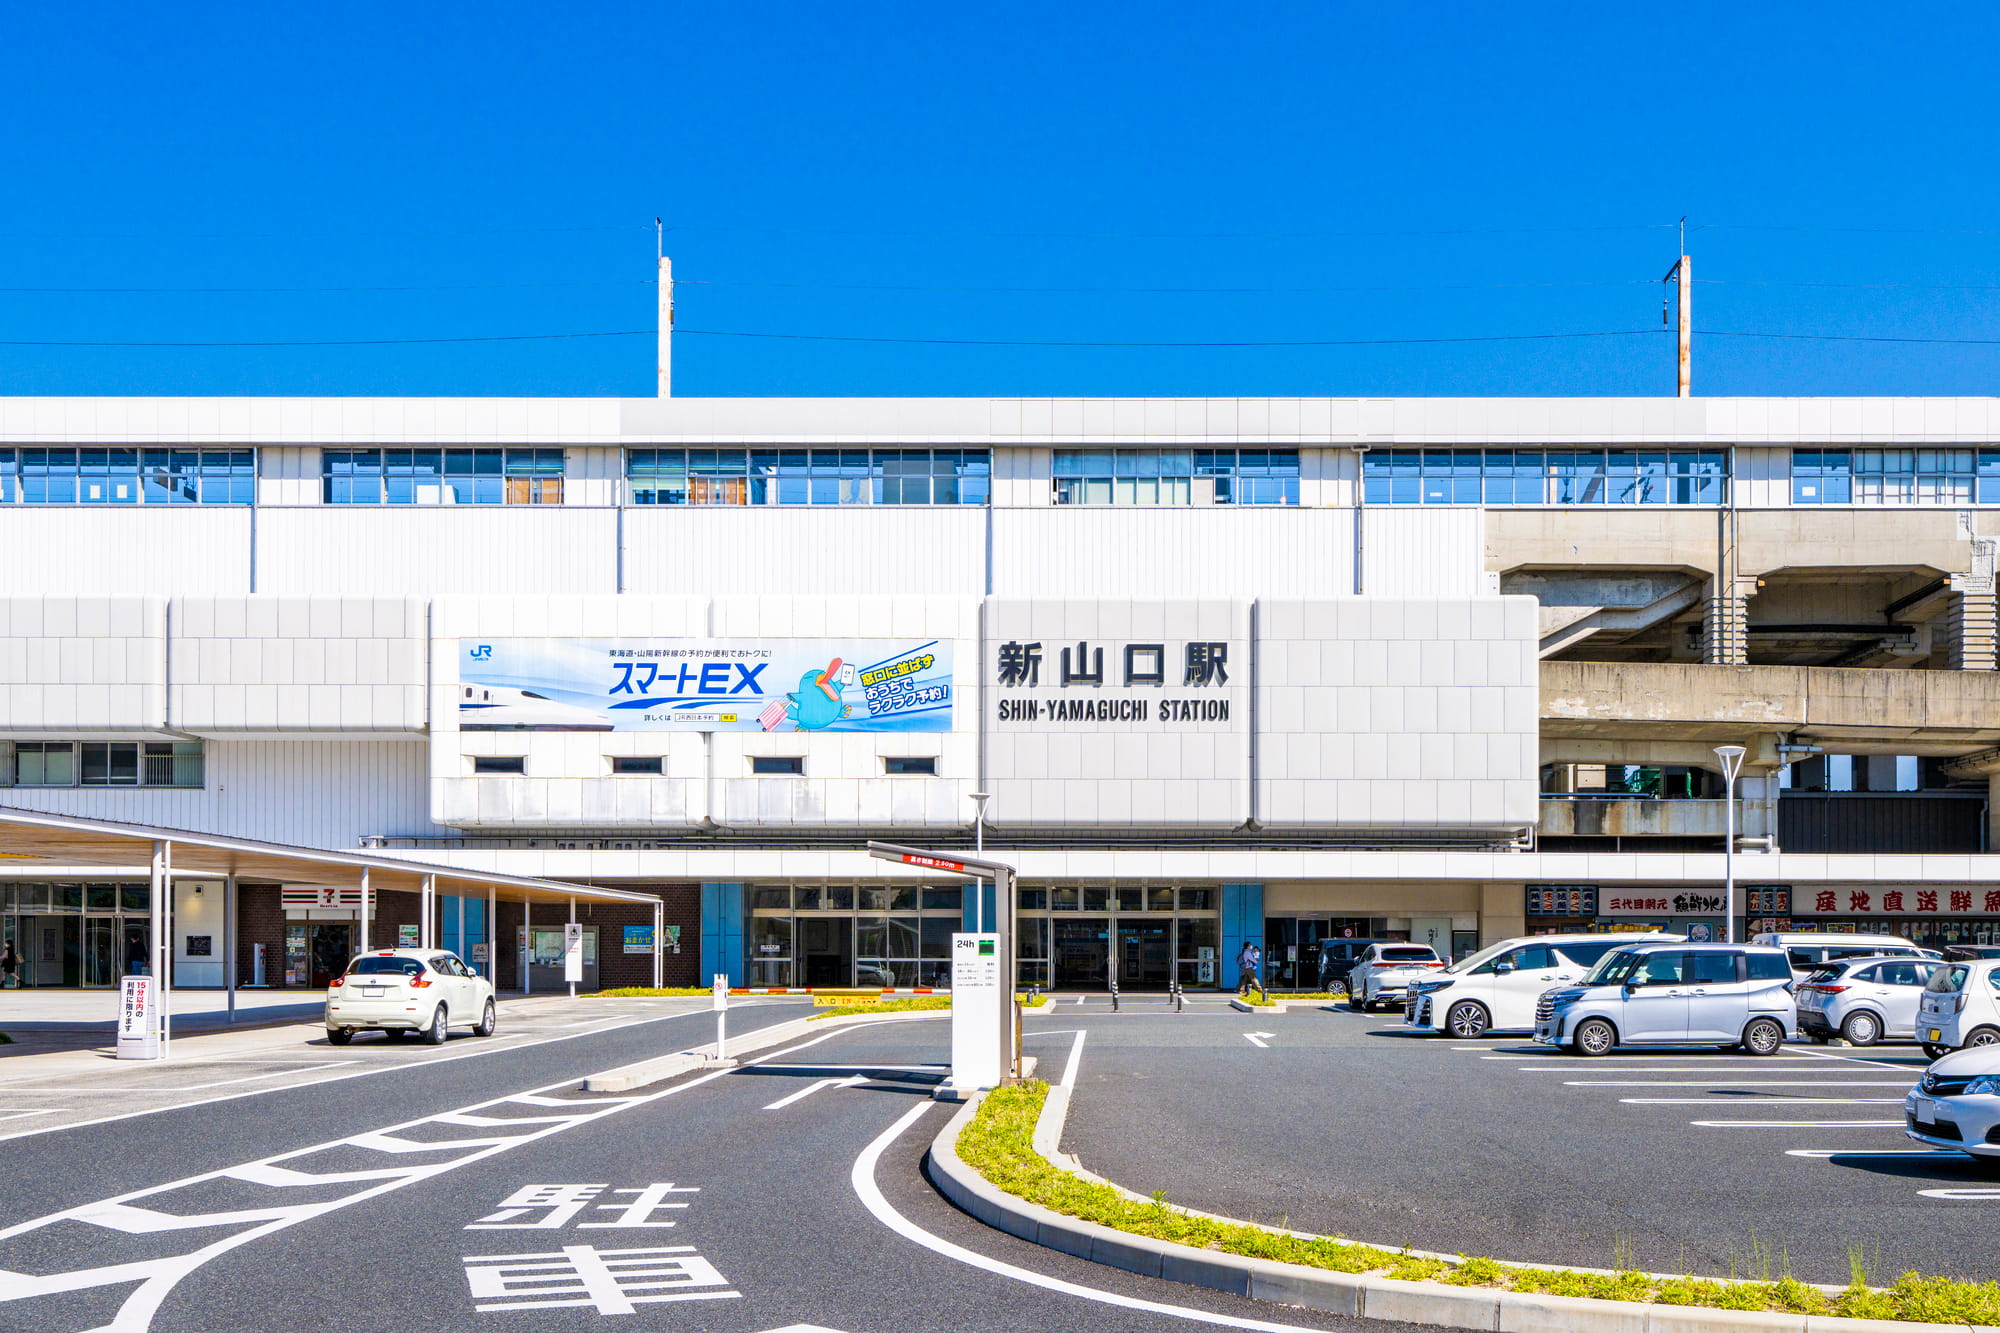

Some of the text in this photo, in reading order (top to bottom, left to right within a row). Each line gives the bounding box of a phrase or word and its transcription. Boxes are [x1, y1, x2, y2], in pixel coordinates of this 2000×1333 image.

[470, 645, 492, 657] JR
[998, 641, 1229, 688] 新山口駅
[609, 663, 769, 695] スマートEX
[860, 653, 935, 687] 窓口に並ばず
[865, 677, 914, 700] おうちで
[868, 685, 949, 715] ラクラク予約!
[999, 699, 1230, 721] SHIN-YAMAGUCHI STATION
[1815, 890, 2000, 912] 産地直送鮮魚
[957, 940, 975, 948] 24h
[125, 981, 135, 1032] 利用に限ります
[135, 981, 147, 1018] 15分以内の
